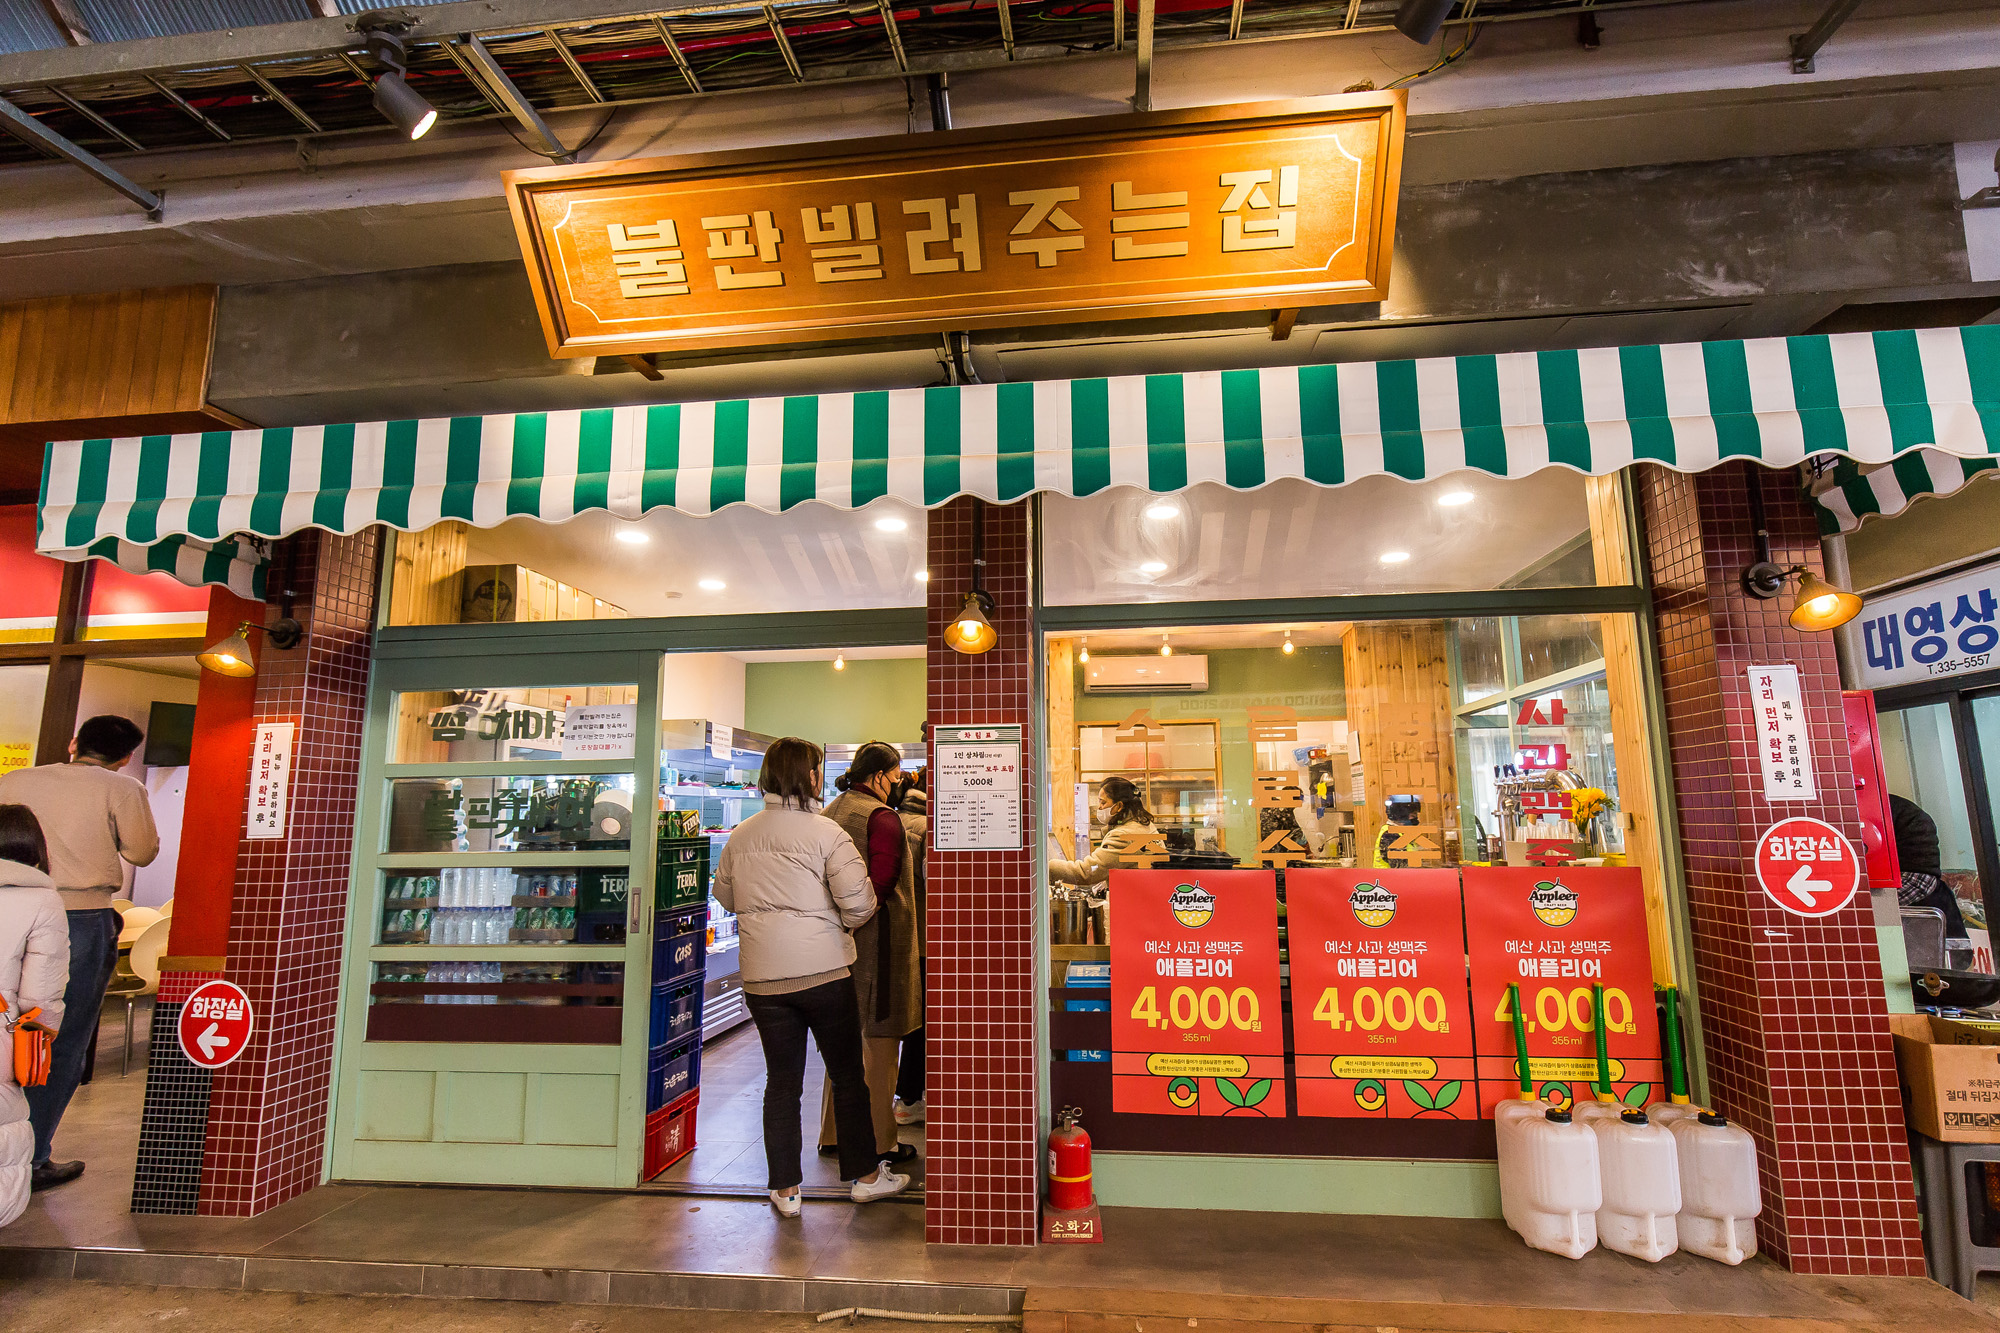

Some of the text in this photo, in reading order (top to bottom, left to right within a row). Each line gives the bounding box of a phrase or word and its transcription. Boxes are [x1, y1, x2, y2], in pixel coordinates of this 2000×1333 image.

[1862, 588, 1999, 671] 대영상
[1926, 654, 1990, 675] T.335-5557
[1760, 675, 1786, 783] 자리 먼저 확보 후
[1782, 701, 1803, 788] 메뉴 주문하세요
[256, 732, 273, 823] 자리 먼저 확보 후
[985, 765, 999, 773] 모두
[269, 753, 282, 828] 메뉴 주문하세요
[963, 778, 993, 786] 5,000원
[1768, 836, 1843, 862] 화장실
[677, 873, 697, 890] TERRA
[1170, 893, 1216, 905] Appleer
[1349, 892, 1397, 904] Appleer
[1529, 891, 1578, 903] Appleer
[1145, 941, 1244, 955] 예산 사과 생맥주
[1325, 940, 1428, 955] 예산 사과 생맥주
[1504, 940, 1612, 955] 예산 사과 생맥주
[1156, 958, 1233, 977] 애플리어
[1337, 959, 1418, 978] 애플리어
[1518, 958, 1601, 978] 애플리어
[191, 997, 244, 1020] 화장실
[1130, 985, 1262, 1032] 4,000원
[1313, 986, 1449, 1033] 4,000원
[1946, 1090, 1967, 1101] 절대
[1051, 1220, 1094, 1233] 소화기
